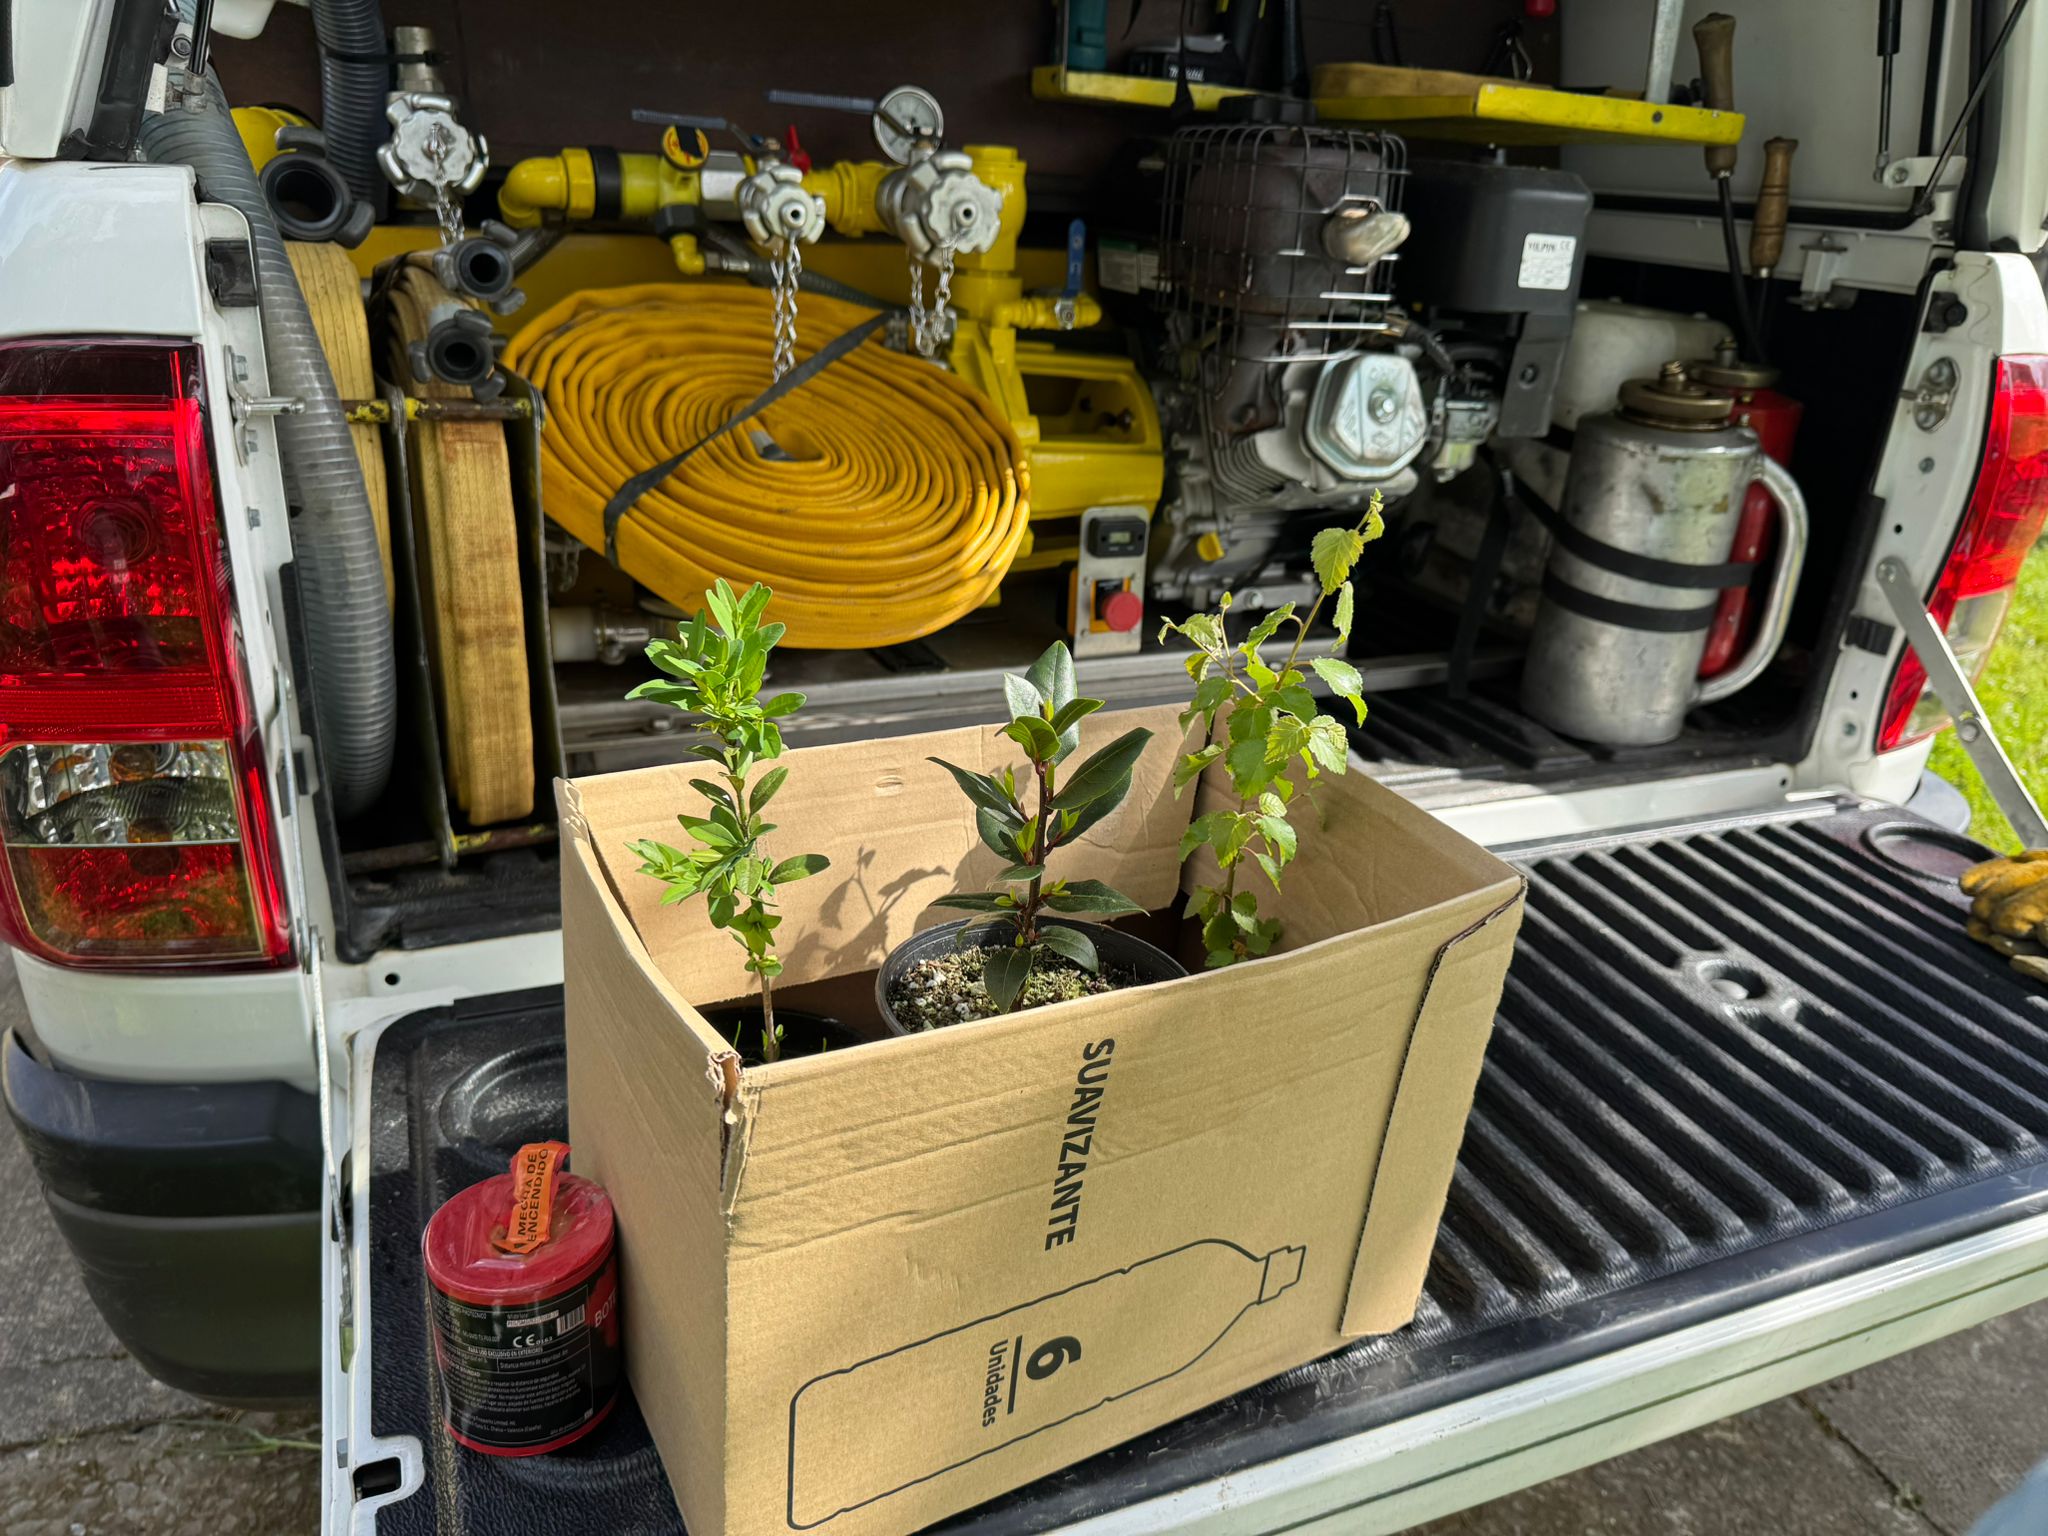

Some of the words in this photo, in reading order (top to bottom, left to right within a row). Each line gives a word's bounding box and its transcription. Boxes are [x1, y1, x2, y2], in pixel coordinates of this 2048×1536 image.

[527, 1154, 537, 1174] DE
[1045, 1038, 1116, 1251] SUAVIZANTE
[528, 1149, 548, 1242] ENCENDIDO
[982, 1338, 1009, 1428] Unidades
[1025, 1335, 1082, 1381] 6
